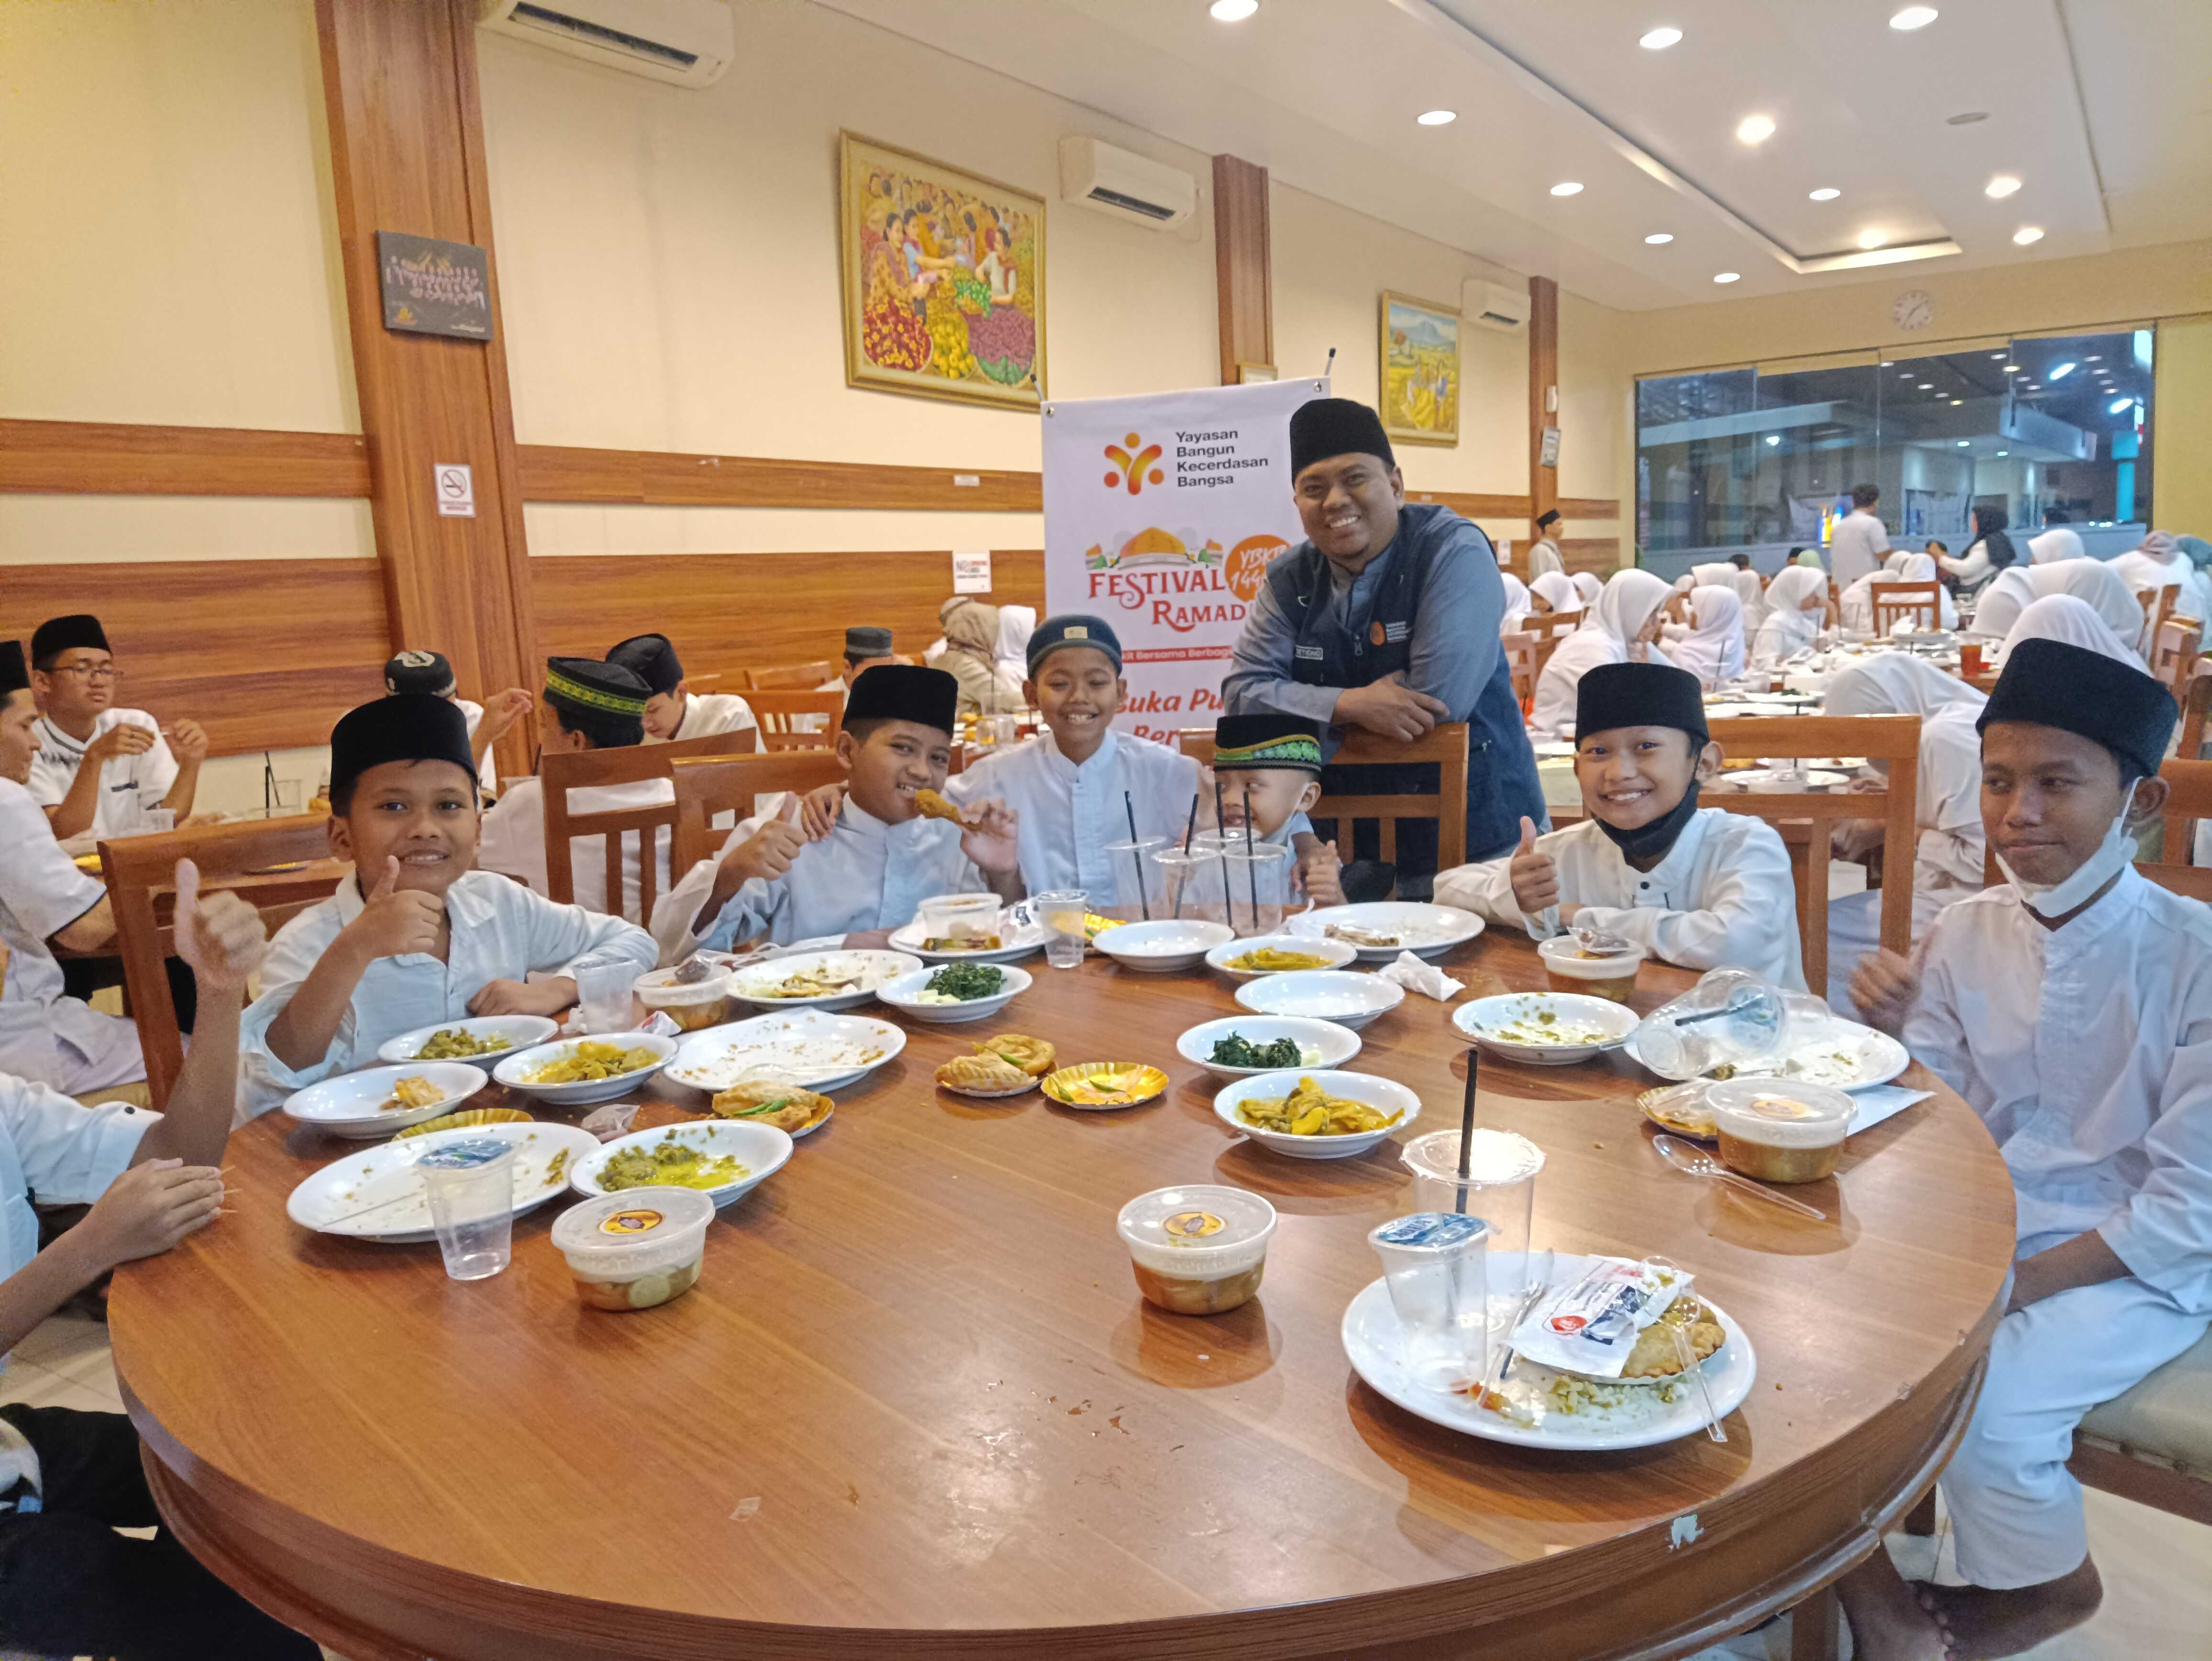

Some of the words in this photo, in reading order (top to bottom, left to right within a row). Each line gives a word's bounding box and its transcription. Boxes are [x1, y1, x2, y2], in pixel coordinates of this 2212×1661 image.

[1176, 429, 1238, 443] Yayasan
[1177, 444, 1235, 459] Bangun
[1177, 457, 1269, 472] Kecerdasan
[1178, 475, 1234, 488] Bangsa
[1088, 567, 1226, 609] FESTIVAL
[1136, 650, 1185, 660] Bersama
